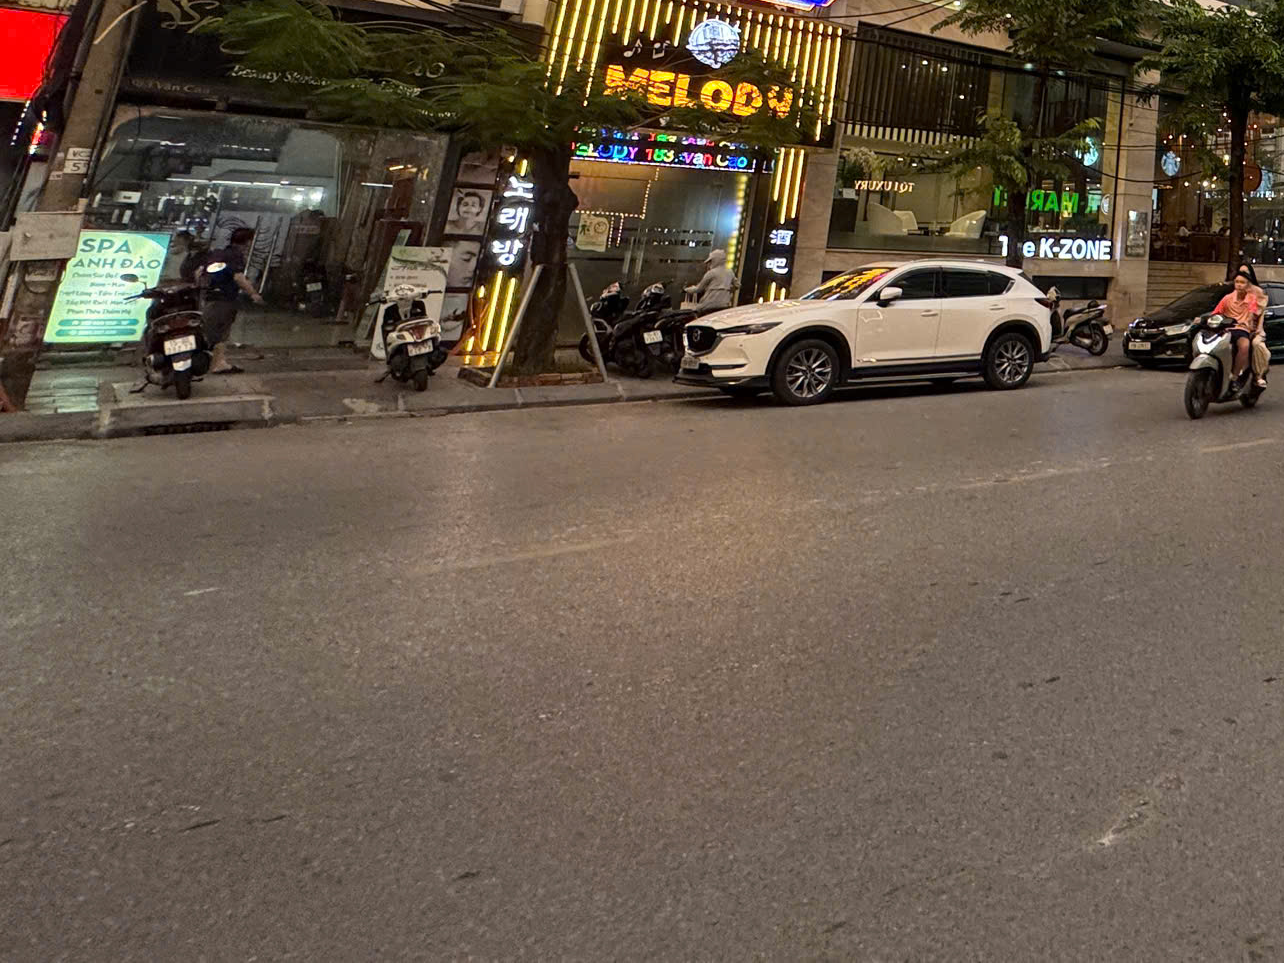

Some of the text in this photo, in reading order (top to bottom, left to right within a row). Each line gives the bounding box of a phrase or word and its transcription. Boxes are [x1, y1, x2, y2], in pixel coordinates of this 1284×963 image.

[491, 175, 534, 267] 노래방
[79, 237, 132, 254] SPA
[765, 228, 795, 275] 酒吧
[998, 234, 1112, 261] Te K-ZONE
[72, 258, 116, 269] ANH
